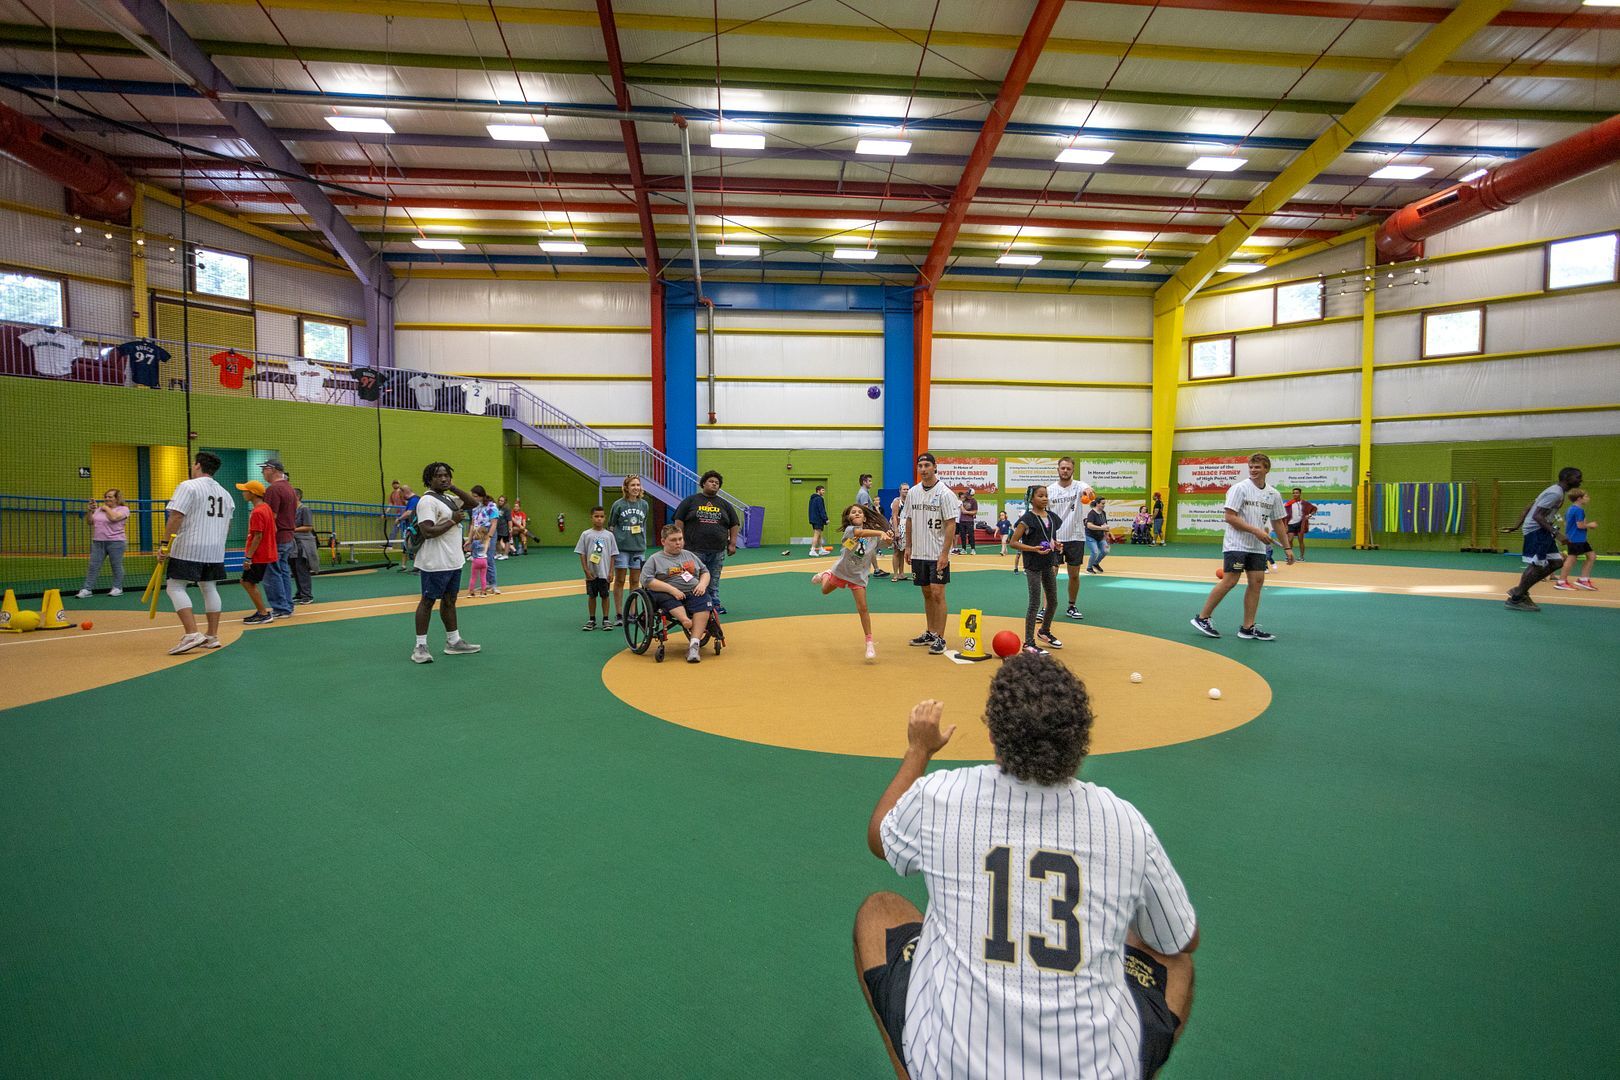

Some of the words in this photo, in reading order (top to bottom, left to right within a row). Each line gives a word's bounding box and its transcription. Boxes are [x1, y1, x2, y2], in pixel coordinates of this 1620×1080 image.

[135, 351, 156, 365] 97
[474, 388, 480, 397] 2
[206, 495, 224, 518] 31
[927, 518, 942, 530] 42
[965, 614, 977, 633] 4
[983, 845, 1083, 977] 13
